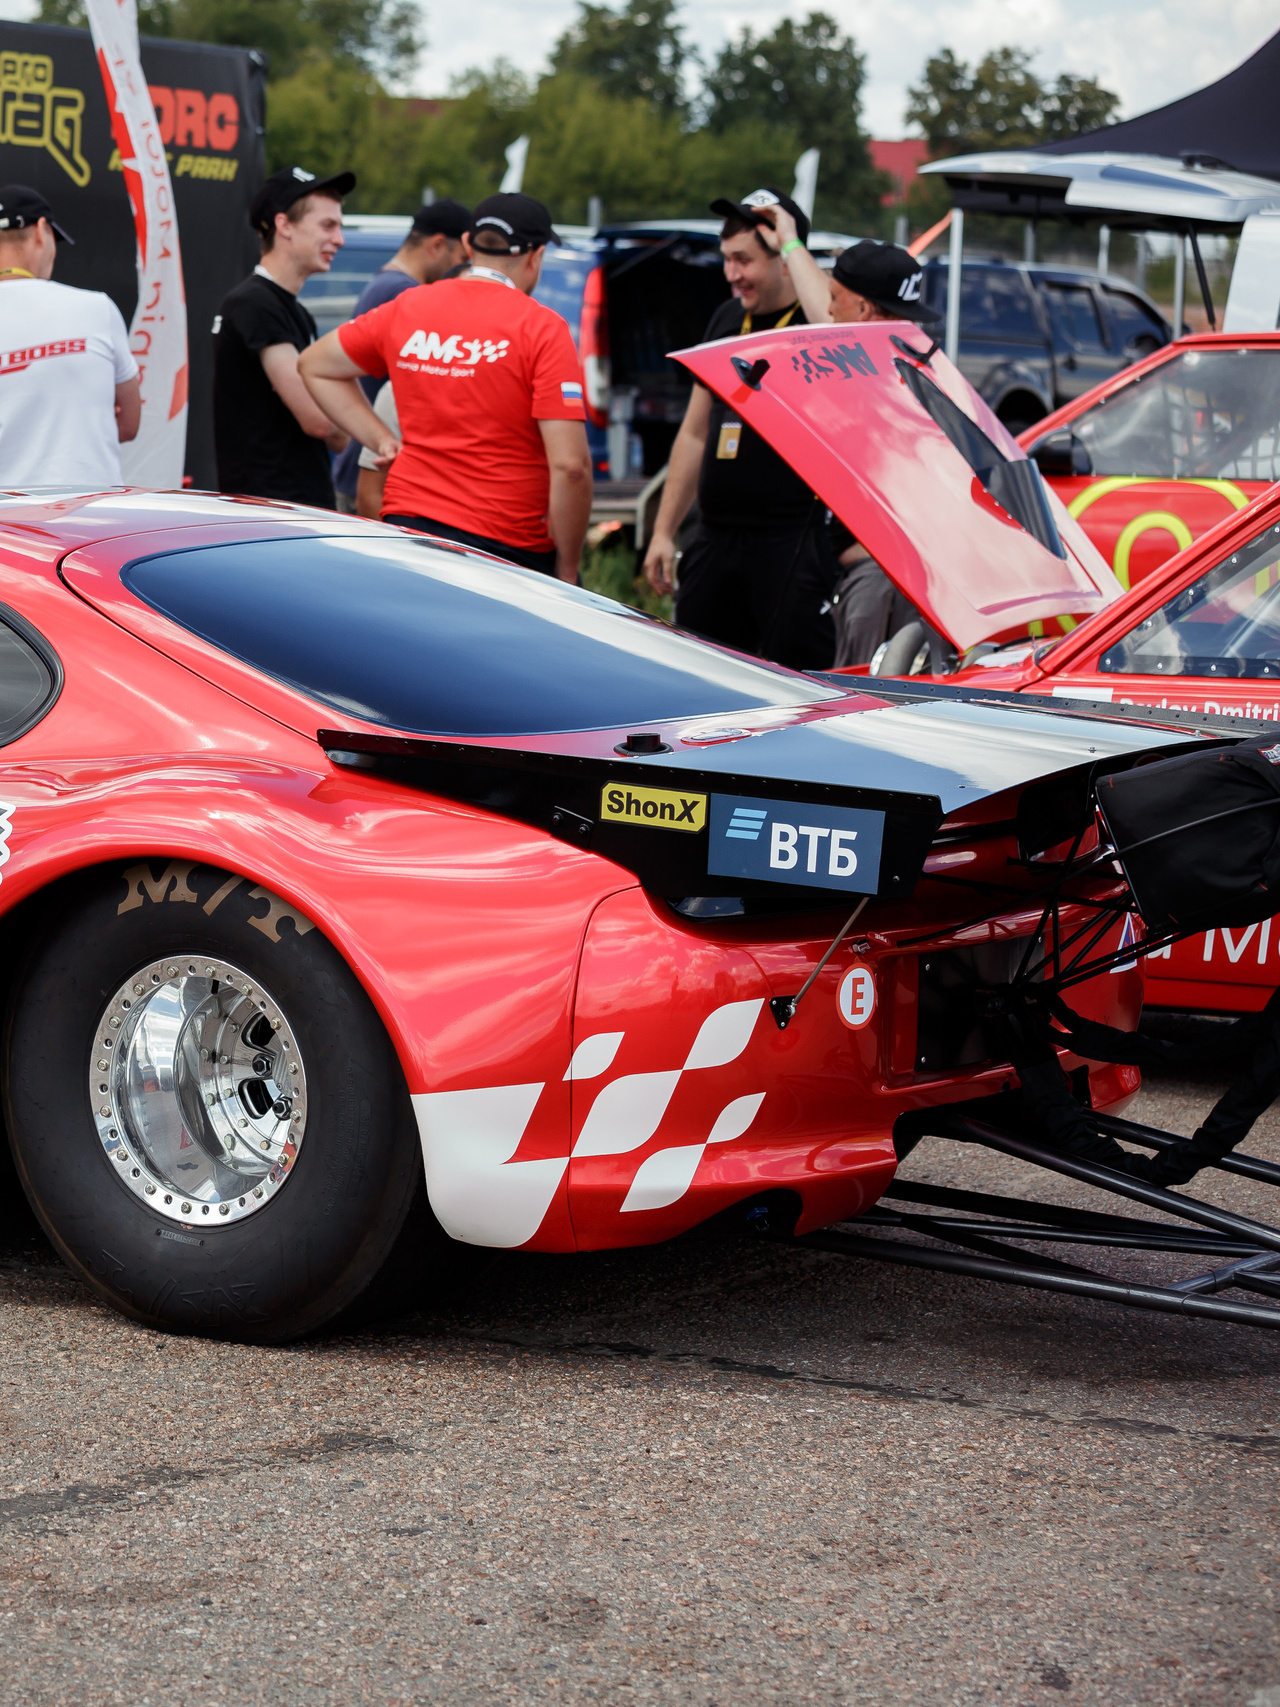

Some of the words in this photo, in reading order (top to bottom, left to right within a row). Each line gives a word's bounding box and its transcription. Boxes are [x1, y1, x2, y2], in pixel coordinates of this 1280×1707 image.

[8, 338, 87, 364] BOSS
[606, 789, 700, 824] ShonX
[770, 822, 858, 877] ВТБ
[851, 976, 865, 1016] E
